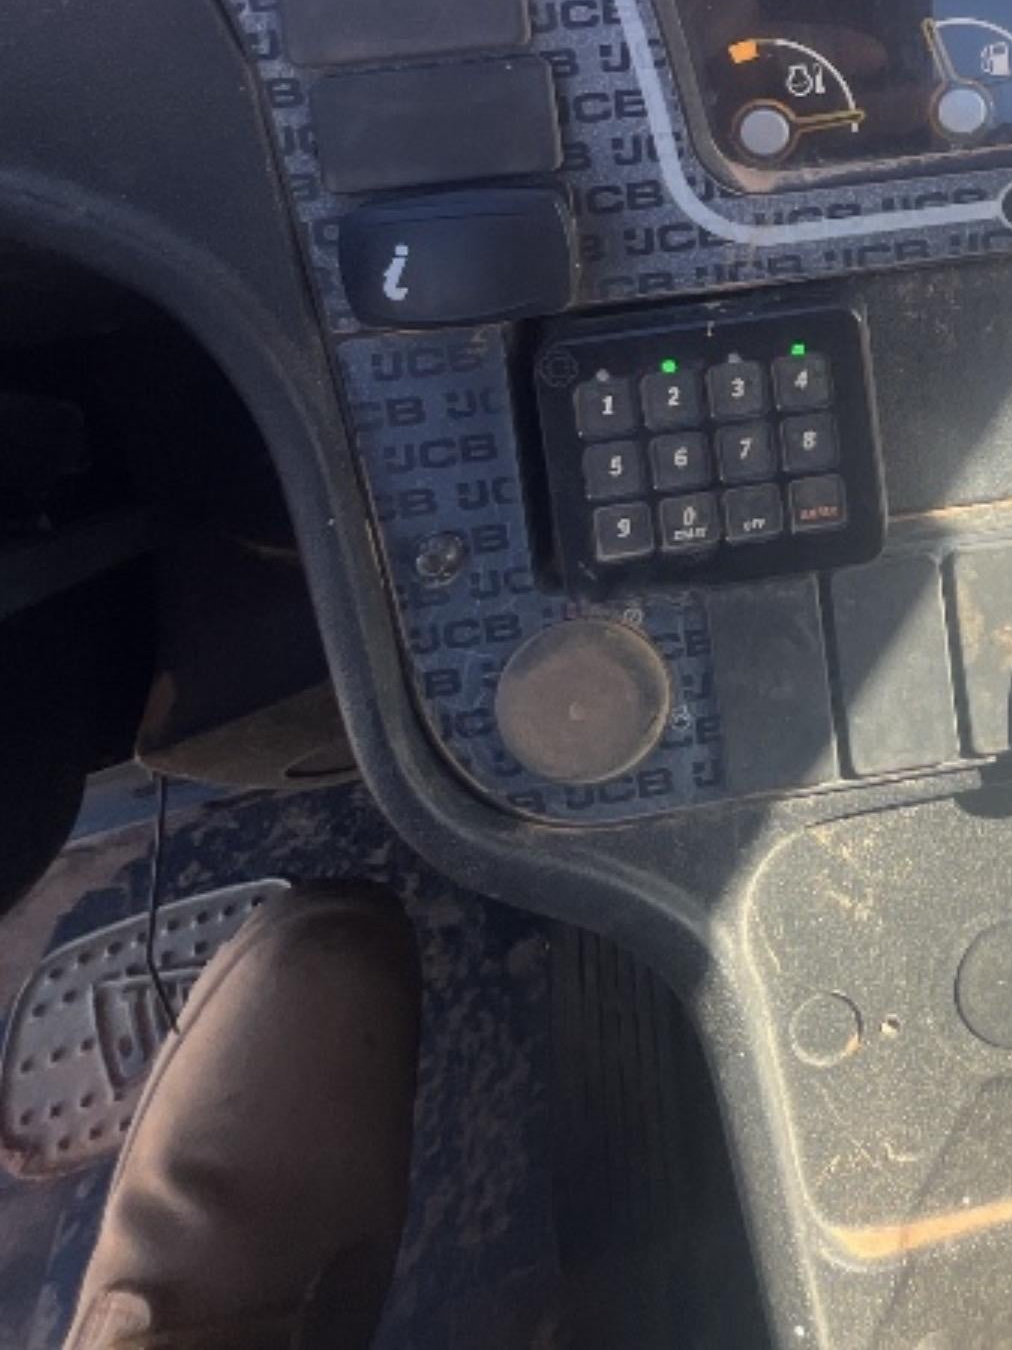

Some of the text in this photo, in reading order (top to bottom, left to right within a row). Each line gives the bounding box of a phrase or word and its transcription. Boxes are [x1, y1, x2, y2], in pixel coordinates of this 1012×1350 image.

[601, 369, 808, 415] 1 2 3 4
[384, 433, 498, 474] JCB
[609, 431, 816, 477] 5 6 7 8
[616, 517, 631, 537] 9
[682, 506, 696, 526] 0
[566, 767, 675, 811] JCB
